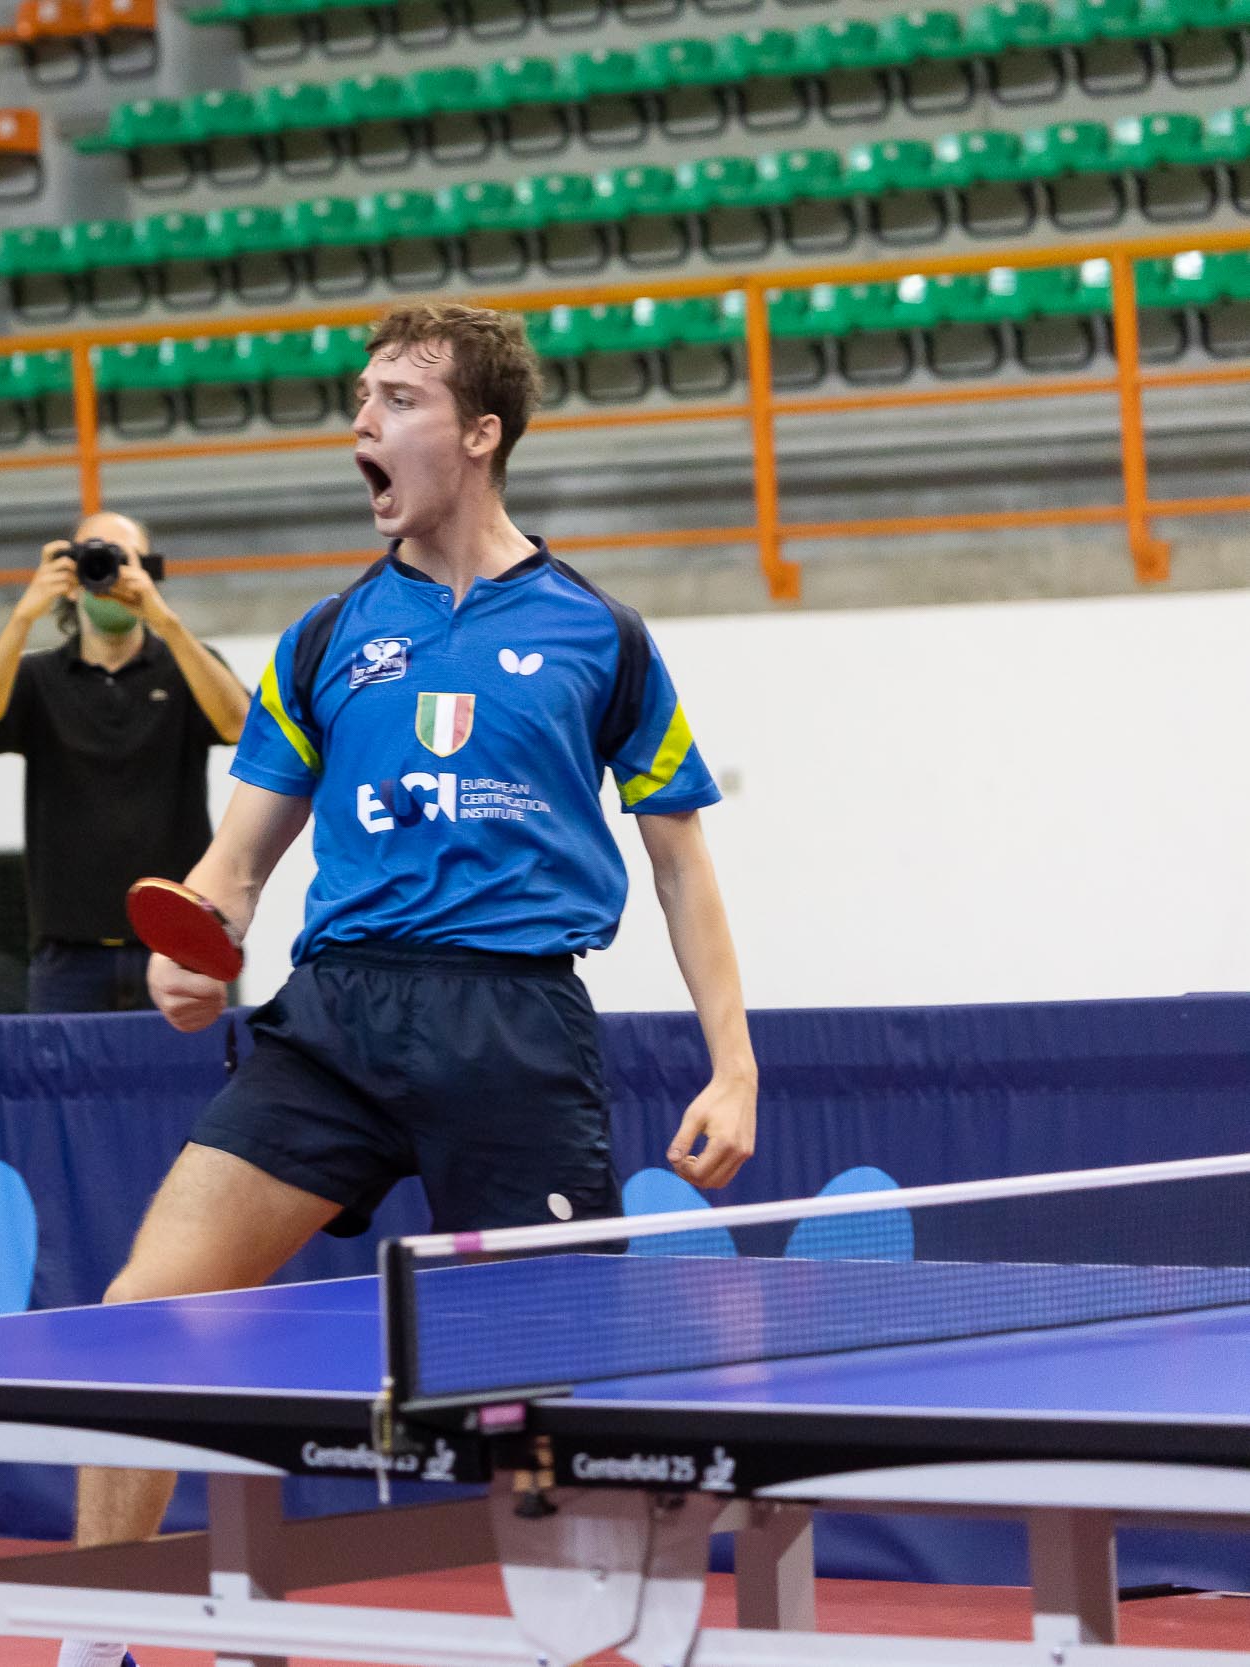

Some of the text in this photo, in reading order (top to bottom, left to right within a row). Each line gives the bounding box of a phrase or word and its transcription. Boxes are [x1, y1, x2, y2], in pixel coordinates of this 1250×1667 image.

[460, 778, 531, 795] EUROPEAN
[460, 793, 552, 813] CERTIFICATION
[460, 808, 527, 822] INSTITUTE
[571, 1452, 697, 1483] Centrefold 25
